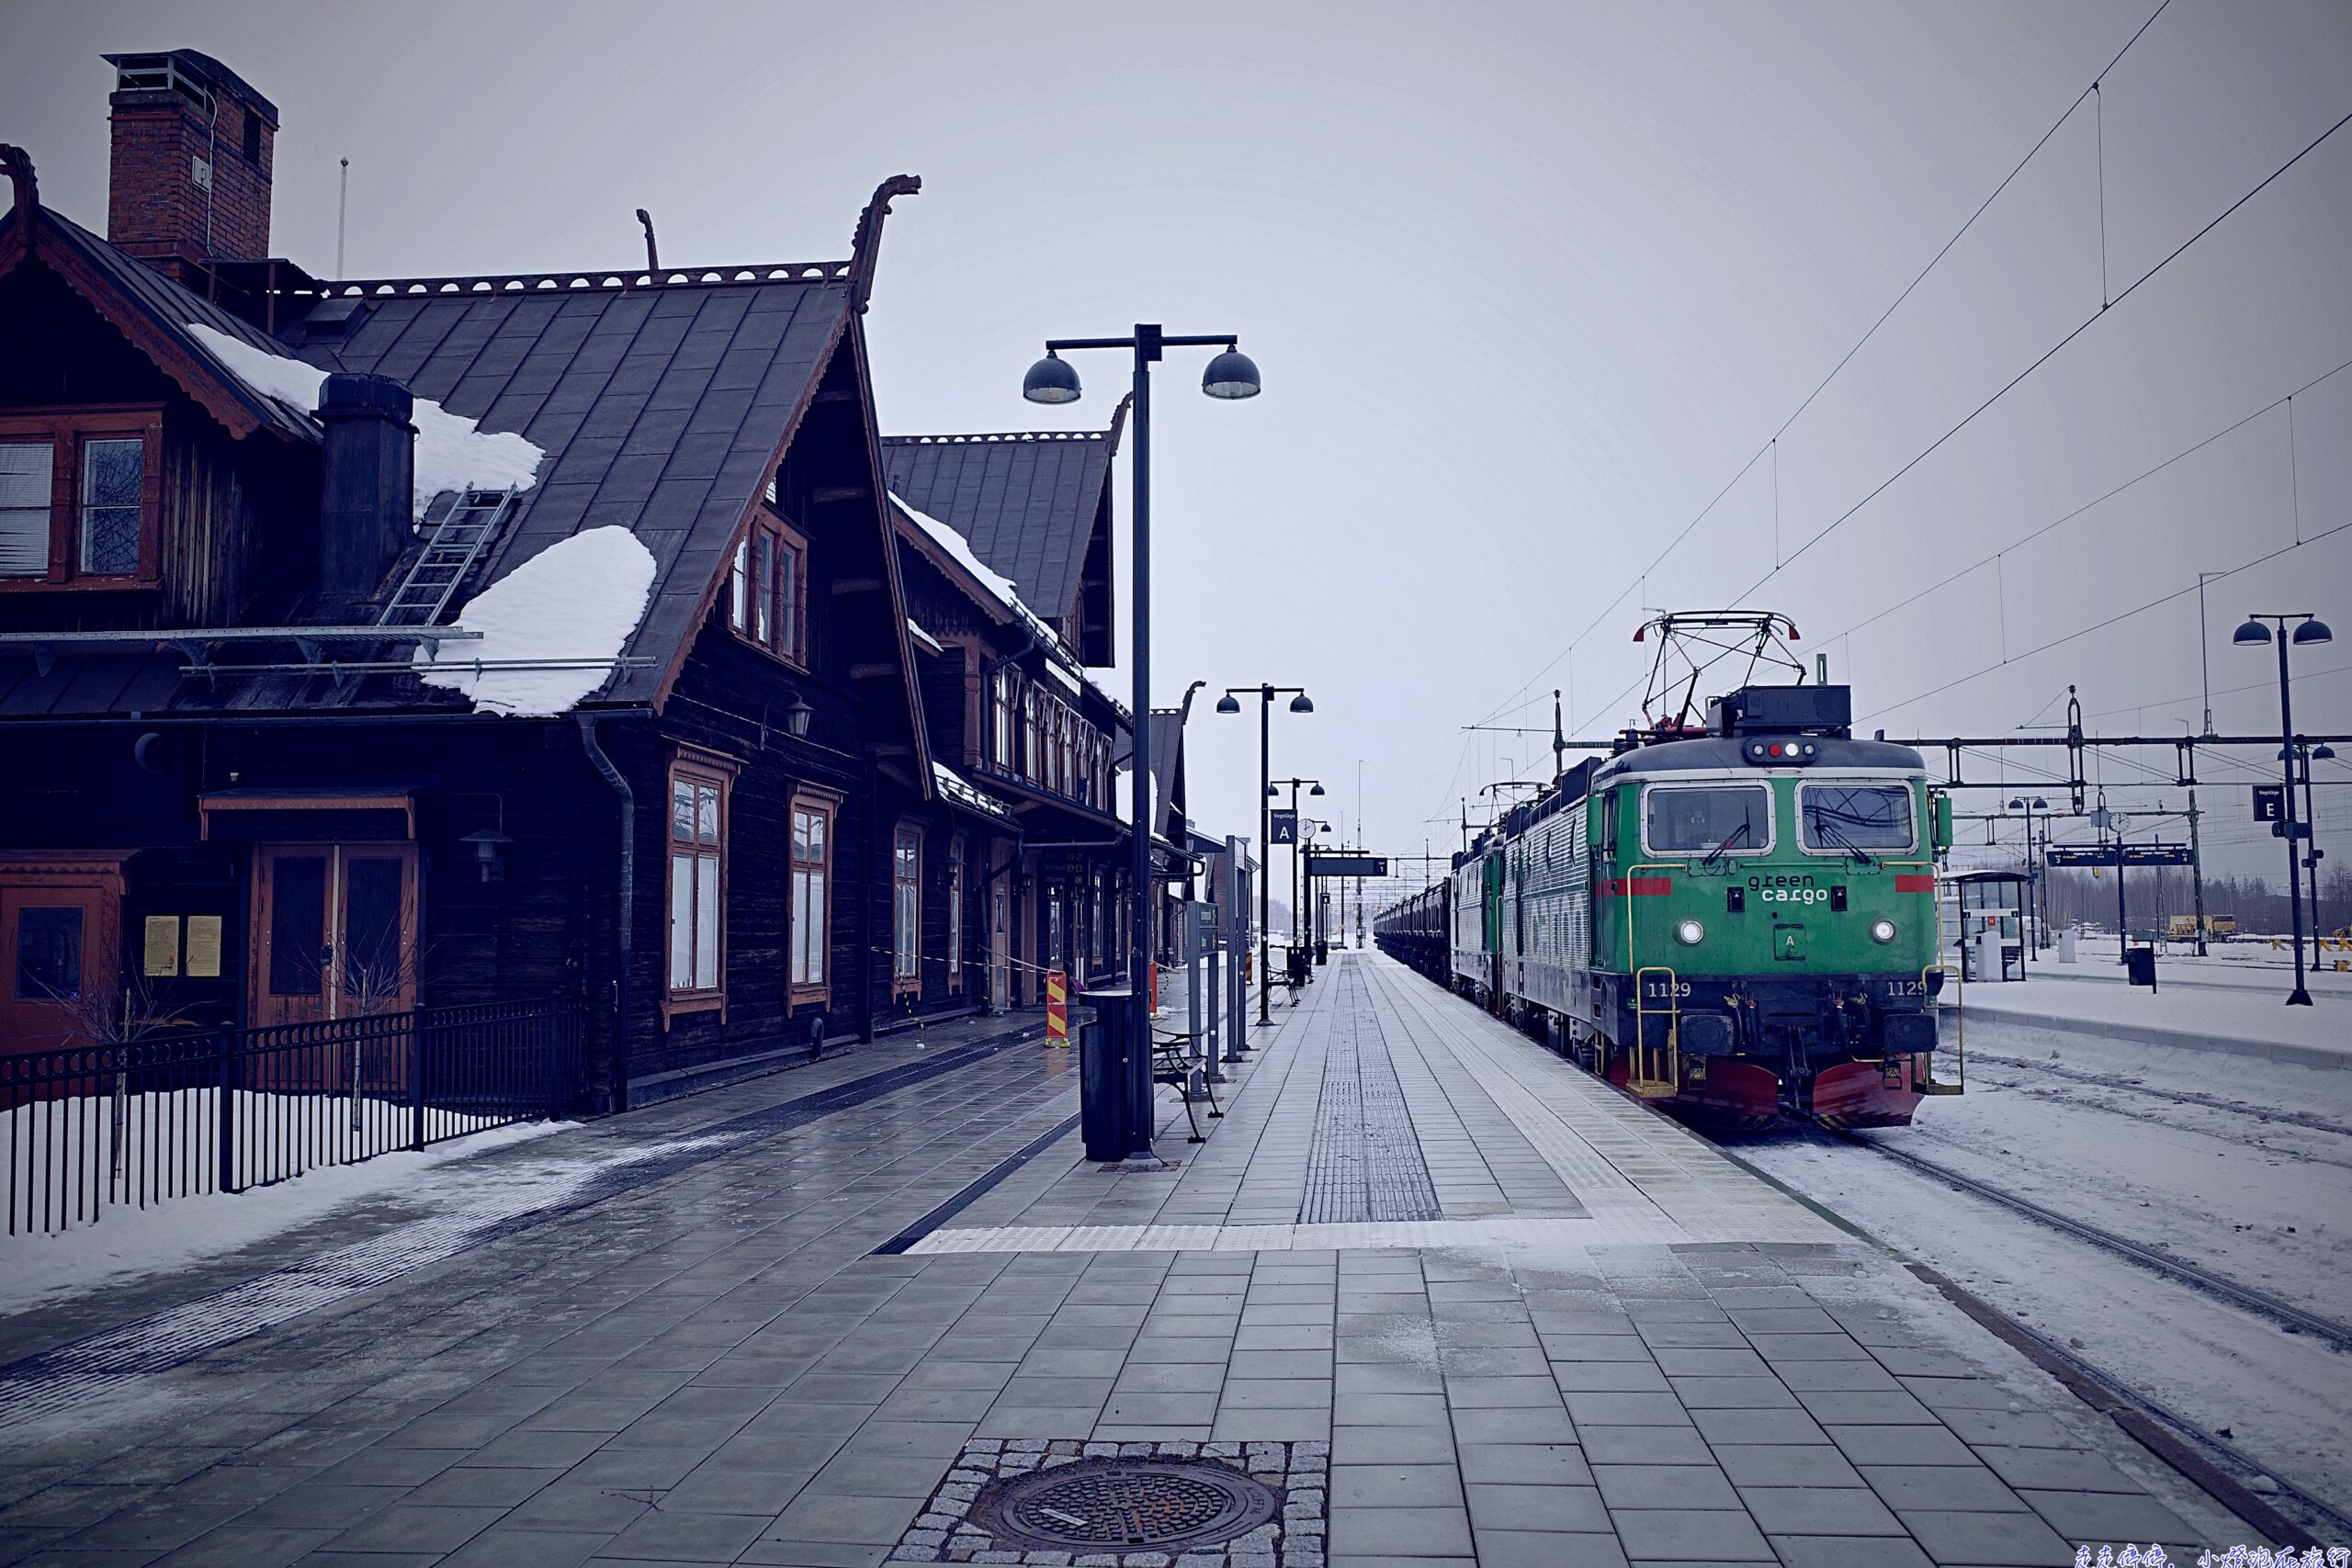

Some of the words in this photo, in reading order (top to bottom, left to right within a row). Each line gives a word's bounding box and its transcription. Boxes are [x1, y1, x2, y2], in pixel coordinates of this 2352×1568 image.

[2266, 803, 2275, 817] E
[1279, 826, 1290, 840] A
[1748, 875, 1815, 892] green
[1761, 888, 1827, 905] cargo
[1786, 935, 1794, 946] A
[1648, 982, 1691, 998] 1129
[1887, 981, 1928, 996] 1129
